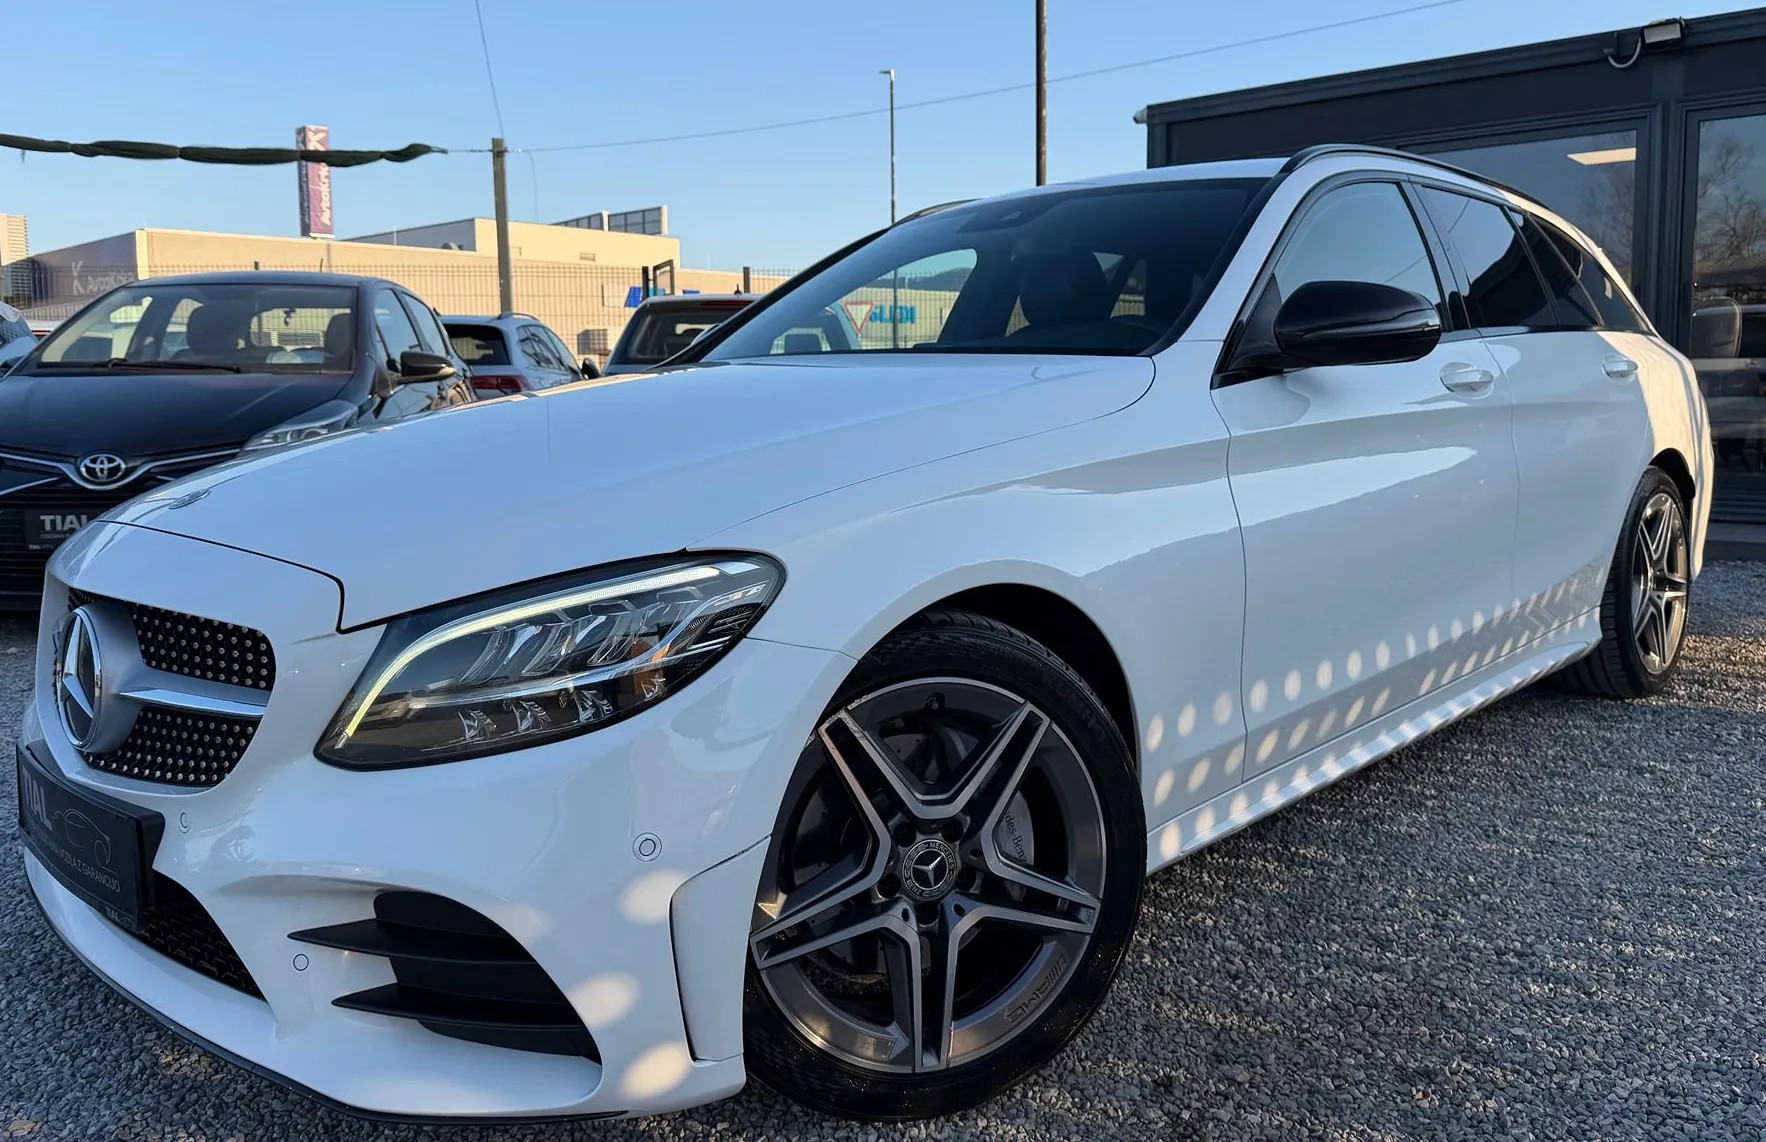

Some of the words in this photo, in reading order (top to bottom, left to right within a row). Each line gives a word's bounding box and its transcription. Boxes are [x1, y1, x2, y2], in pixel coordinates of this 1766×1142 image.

[22, 764, 52, 831] TIAL
[929, 842, 955, 869] MERCEDES
[906, 879, 922, 896] BENZ
